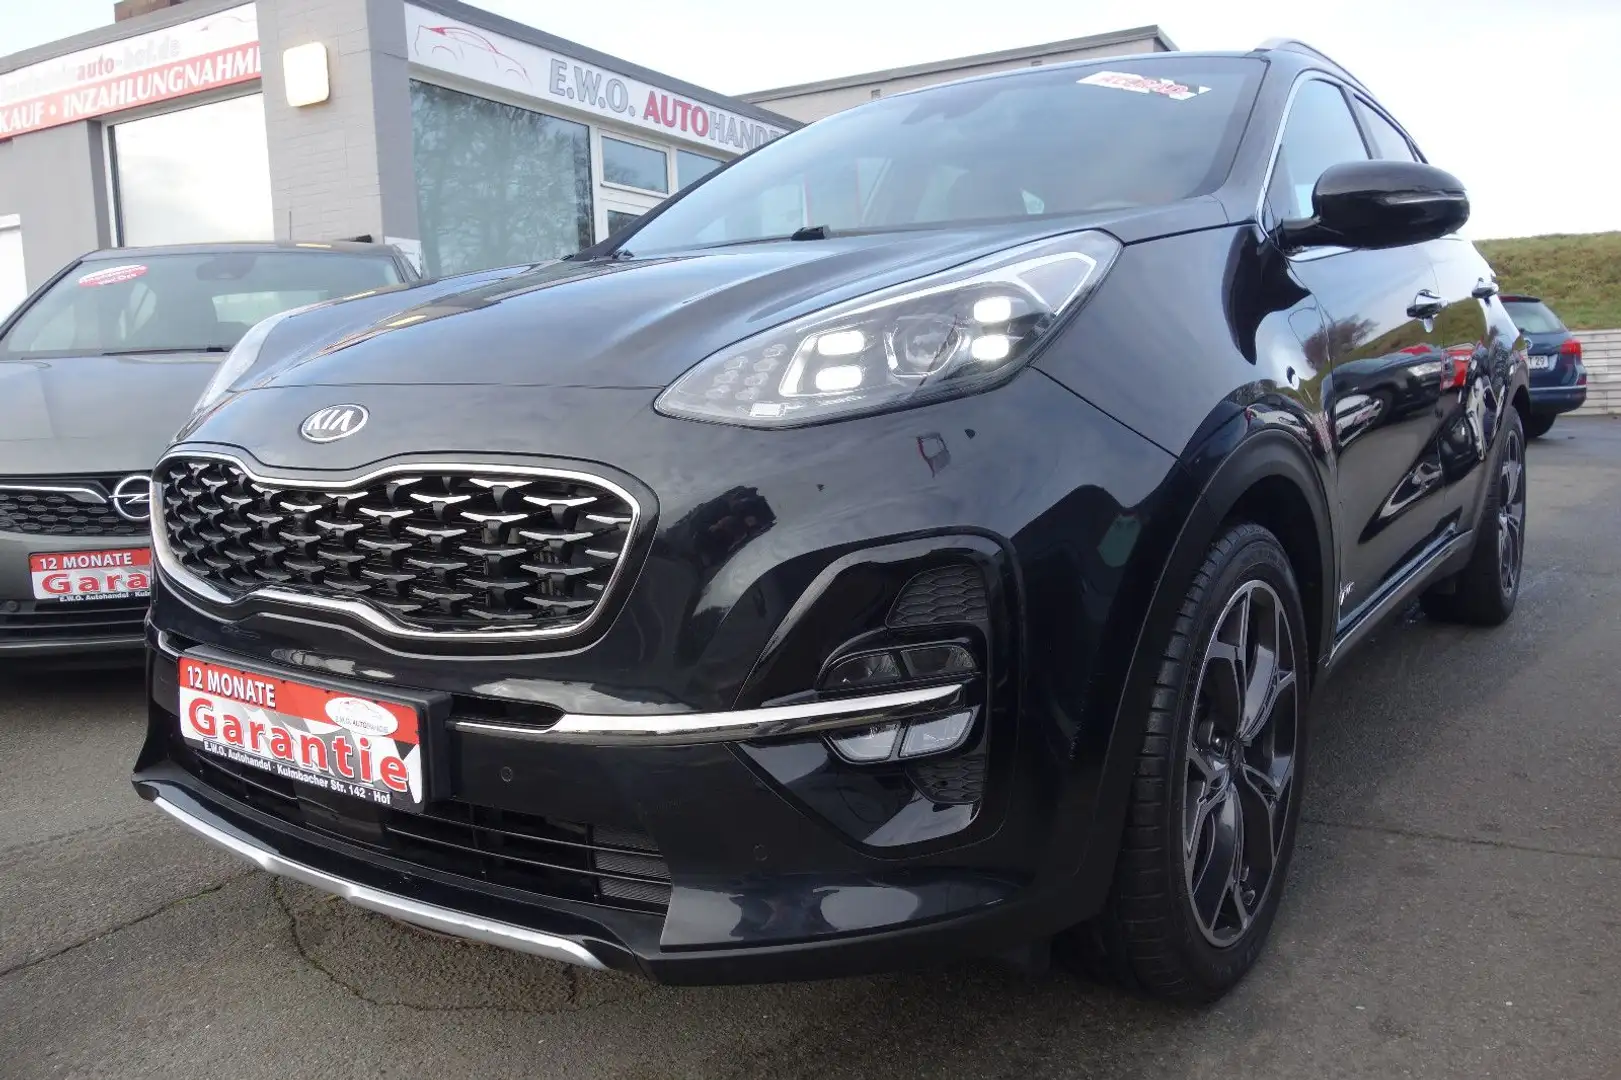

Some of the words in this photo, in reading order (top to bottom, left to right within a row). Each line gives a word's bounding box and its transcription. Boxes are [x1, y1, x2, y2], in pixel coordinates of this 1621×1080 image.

[549, 58, 636, 118] E.W.O.
[643, 91, 786, 151] AUTOHAND
[306, 409, 355, 432] KIA
[39, 557, 58, 570] 12
[62, 552, 133, 569] MONATE
[41, 573, 149, 594] Gara
[85, 592, 129, 601] Autohandel
[187, 665, 203, 689] 12
[207, 670, 276, 708] MONATE
[188, 697, 408, 792] Garantie
[203, 741, 227, 757] E.W.O.
[228, 748, 271, 772] Autohandel
[277, 764, 328, 789] Kulmbacher
[330, 780, 347, 794] Str.
[348, 785, 366, 799] 142
[373, 791, 391, 805] Hof
